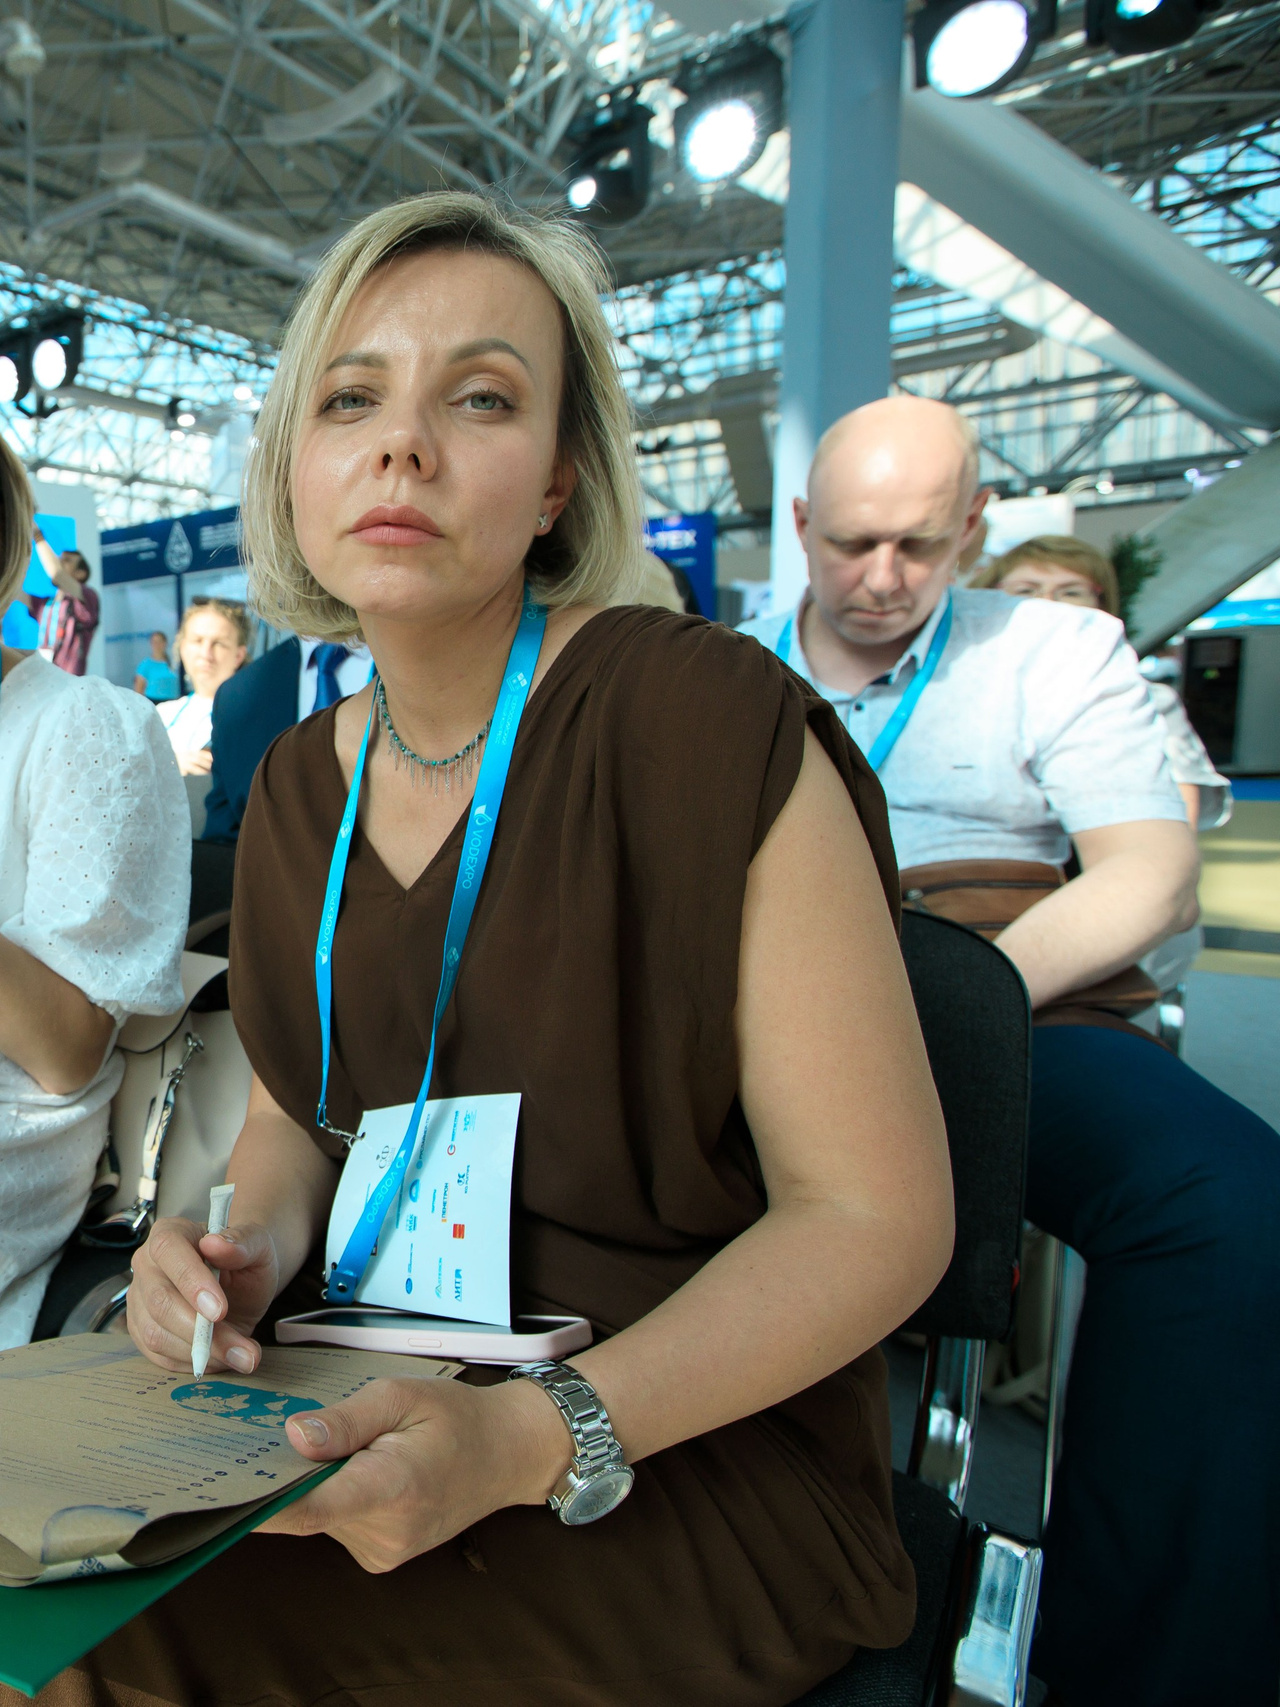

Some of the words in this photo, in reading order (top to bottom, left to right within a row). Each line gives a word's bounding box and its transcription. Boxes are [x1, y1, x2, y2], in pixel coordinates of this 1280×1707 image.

[462, 828, 485, 889] VODEXPO
[322, 890, 338, 942] VODEXPO
[366, 1171, 398, 1224] VODEXPO
[254, 1470, 277, 1480] 14
